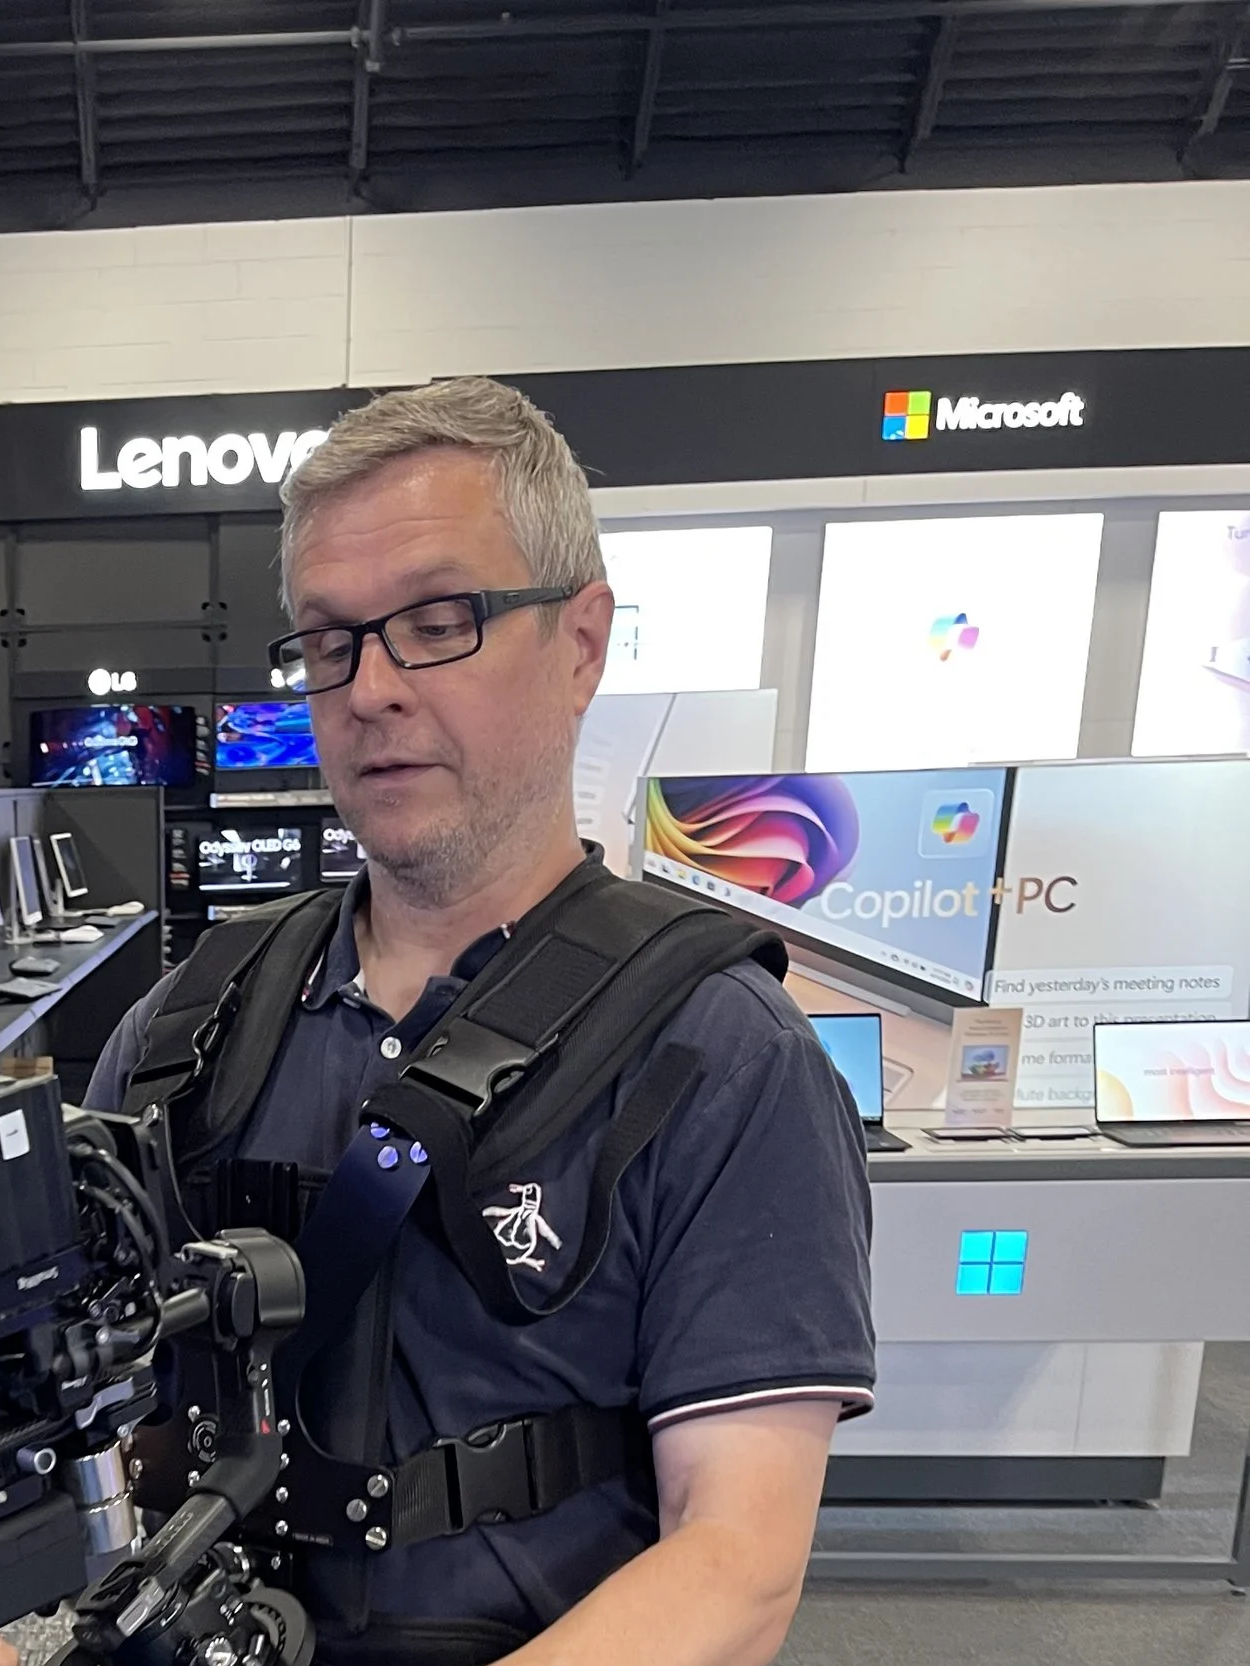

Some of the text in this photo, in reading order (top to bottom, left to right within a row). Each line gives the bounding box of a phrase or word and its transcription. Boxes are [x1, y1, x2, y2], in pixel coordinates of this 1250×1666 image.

[935, 392, 1085, 430] Microsoft
[994, 976, 1221, 997] Find yesterday's meeting notes
[1024, 1014, 1045, 1029] 3D
[1048, 1015, 1071, 1029] art
[1073, 1015, 1090, 1028] to
